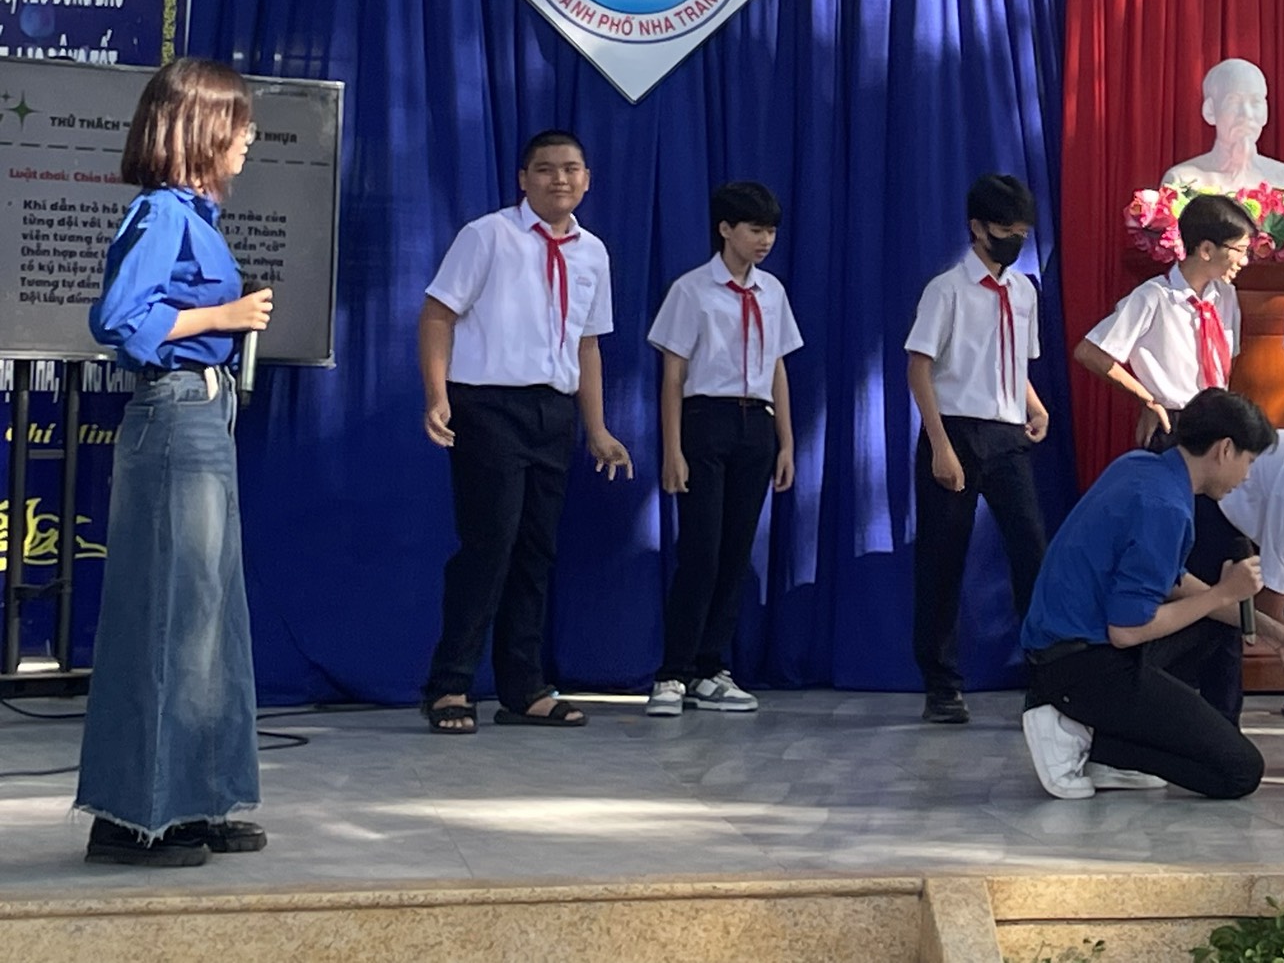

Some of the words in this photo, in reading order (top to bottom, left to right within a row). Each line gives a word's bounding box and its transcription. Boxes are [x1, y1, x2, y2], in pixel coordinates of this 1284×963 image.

[597, 14, 633, 37] PHỐ
[639, 16, 676, 36] NHA
[23, 200, 47, 211] Khi
